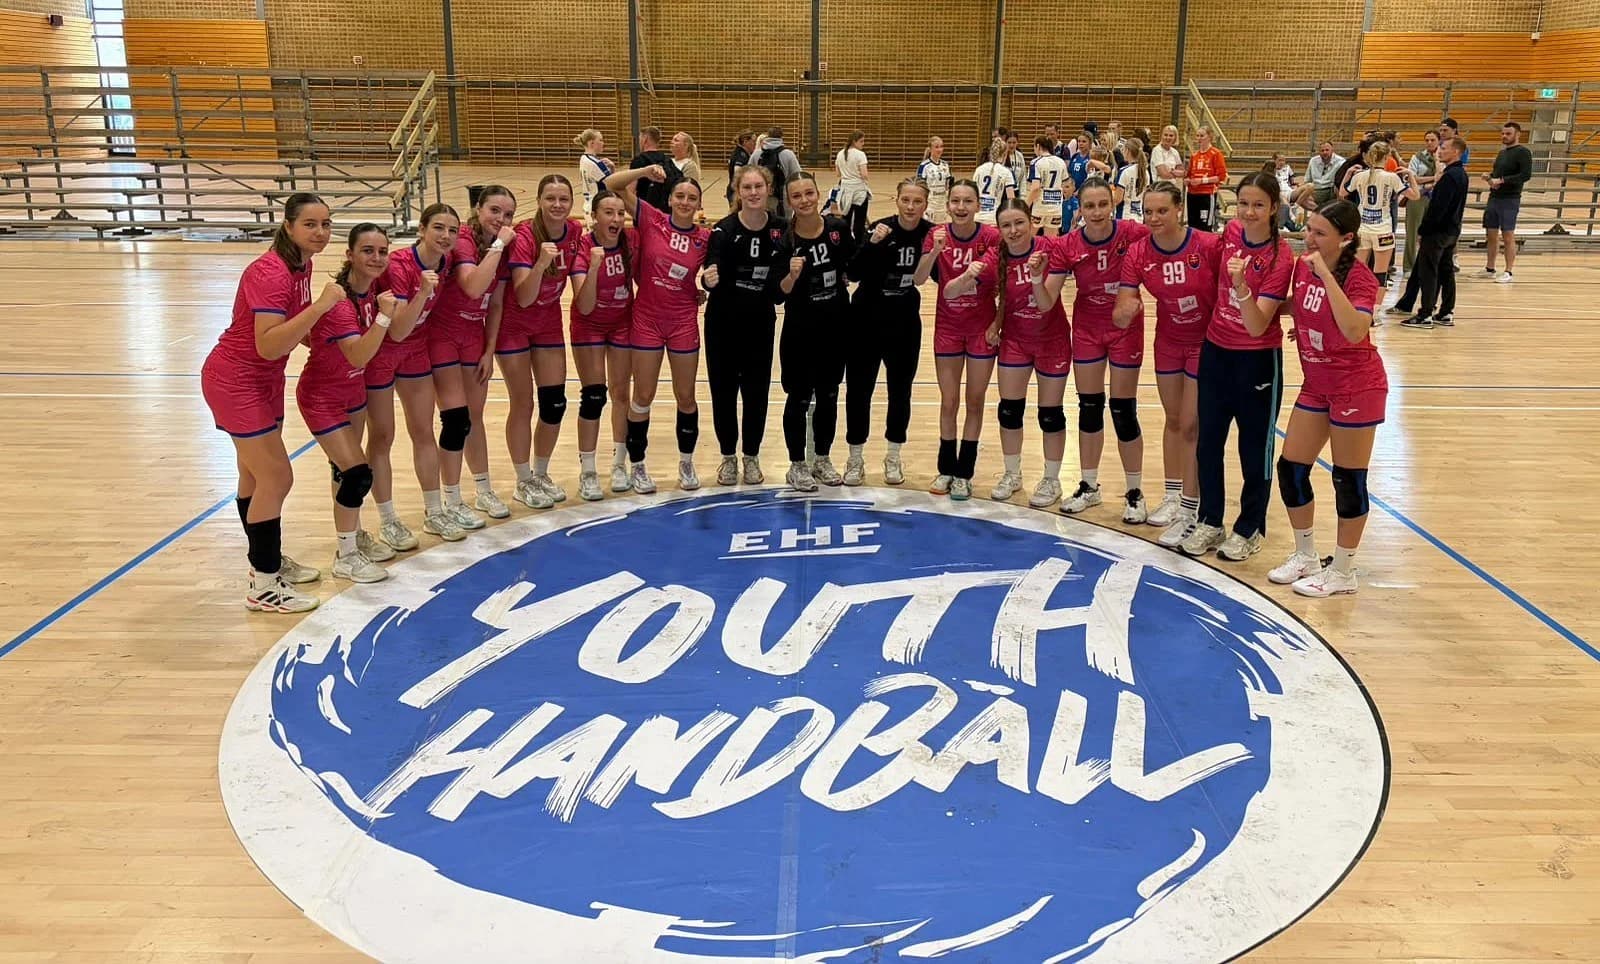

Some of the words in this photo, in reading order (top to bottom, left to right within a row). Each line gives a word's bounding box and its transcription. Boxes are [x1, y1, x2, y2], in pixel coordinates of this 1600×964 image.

[982, 175, 992, 194] 2
[1049, 170, 1058, 188] 7
[1367, 185, 1377, 205] 9
[669, 232, 689, 254] 88
[750, 237, 760, 258] 6
[605, 254, 625, 277] 83
[809, 243, 831, 266] 12
[896, 246, 915, 266] 16
[952, 247, 973, 269] 24
[1097, 249, 1108, 271] 5
[1162, 260, 1186, 285] 99
[300, 277, 310, 305] 18
[1302, 284, 1325, 313] 66
[728, 522, 881, 553] EHF
[398, 556, 1144, 709] YOUTH
[362, 672, 1255, 824] HANDBALL
